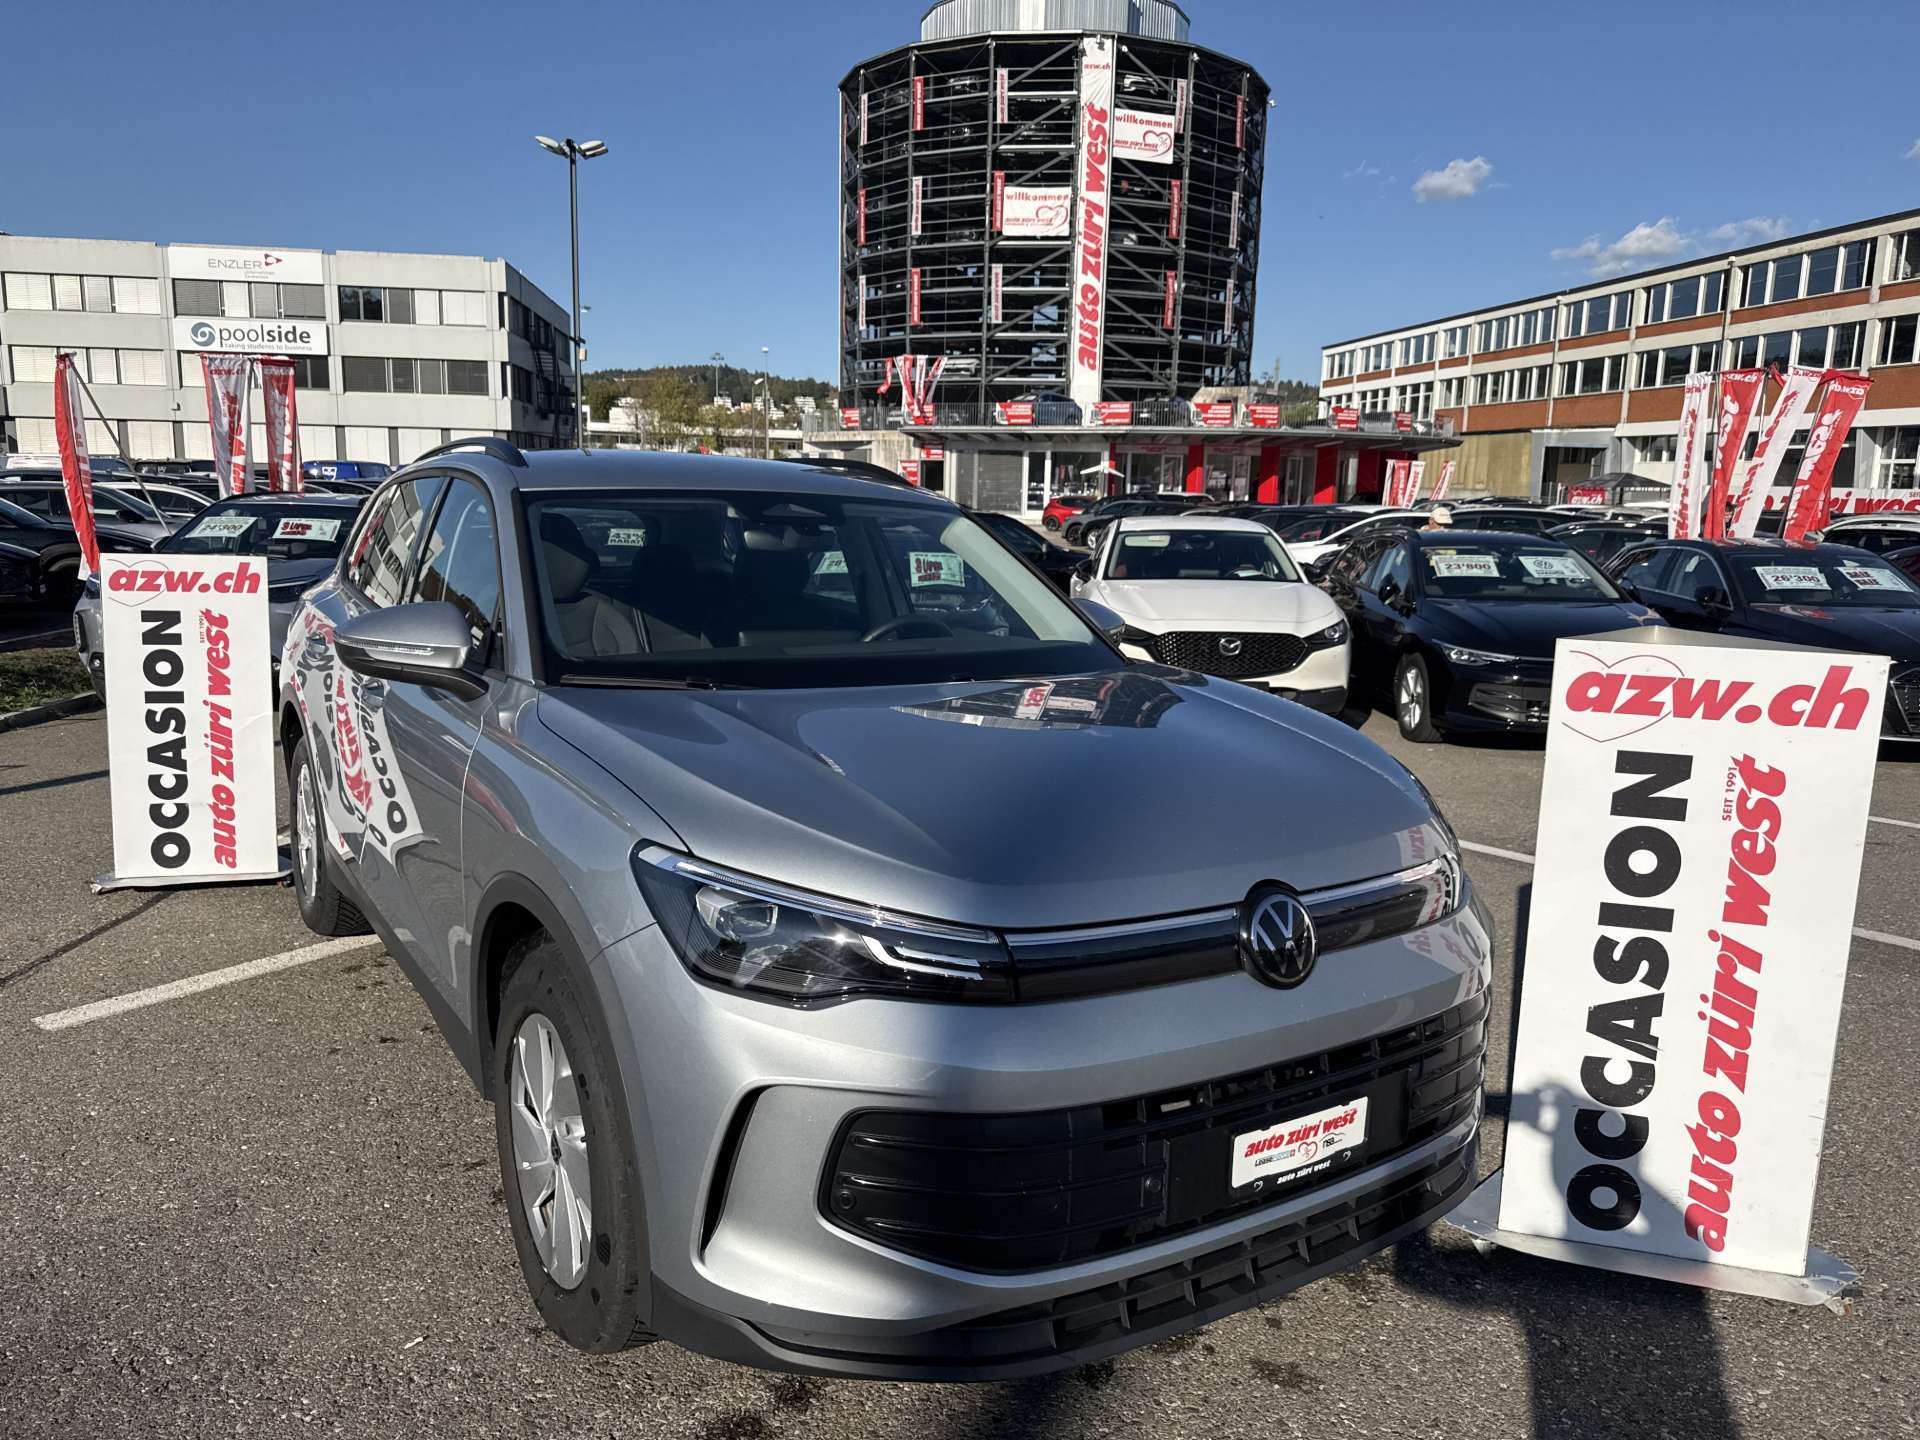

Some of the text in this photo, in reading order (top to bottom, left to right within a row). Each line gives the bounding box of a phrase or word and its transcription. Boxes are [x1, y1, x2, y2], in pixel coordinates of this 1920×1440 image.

[1115, 114, 1173, 129] willkommen
[1077, 101, 1108, 371] auto züri west
[207, 258, 262, 269] ENZLER
[219, 323, 311, 348] poolside
[108, 561, 261, 594] azw.ch
[1566, 665, 1870, 731] azw.ch
[140, 610, 191, 869] OCCASION
[200, 607, 237, 869] auto züri west
[1721, 767, 1738, 821] SEIT 1991
[1565, 749, 1694, 1232] OCCASION
[1684, 753, 1788, 1253] auto züri west
[1244, 1109, 1357, 1158] auto züri west
[1276, 1159, 1332, 1185] auto züri west
